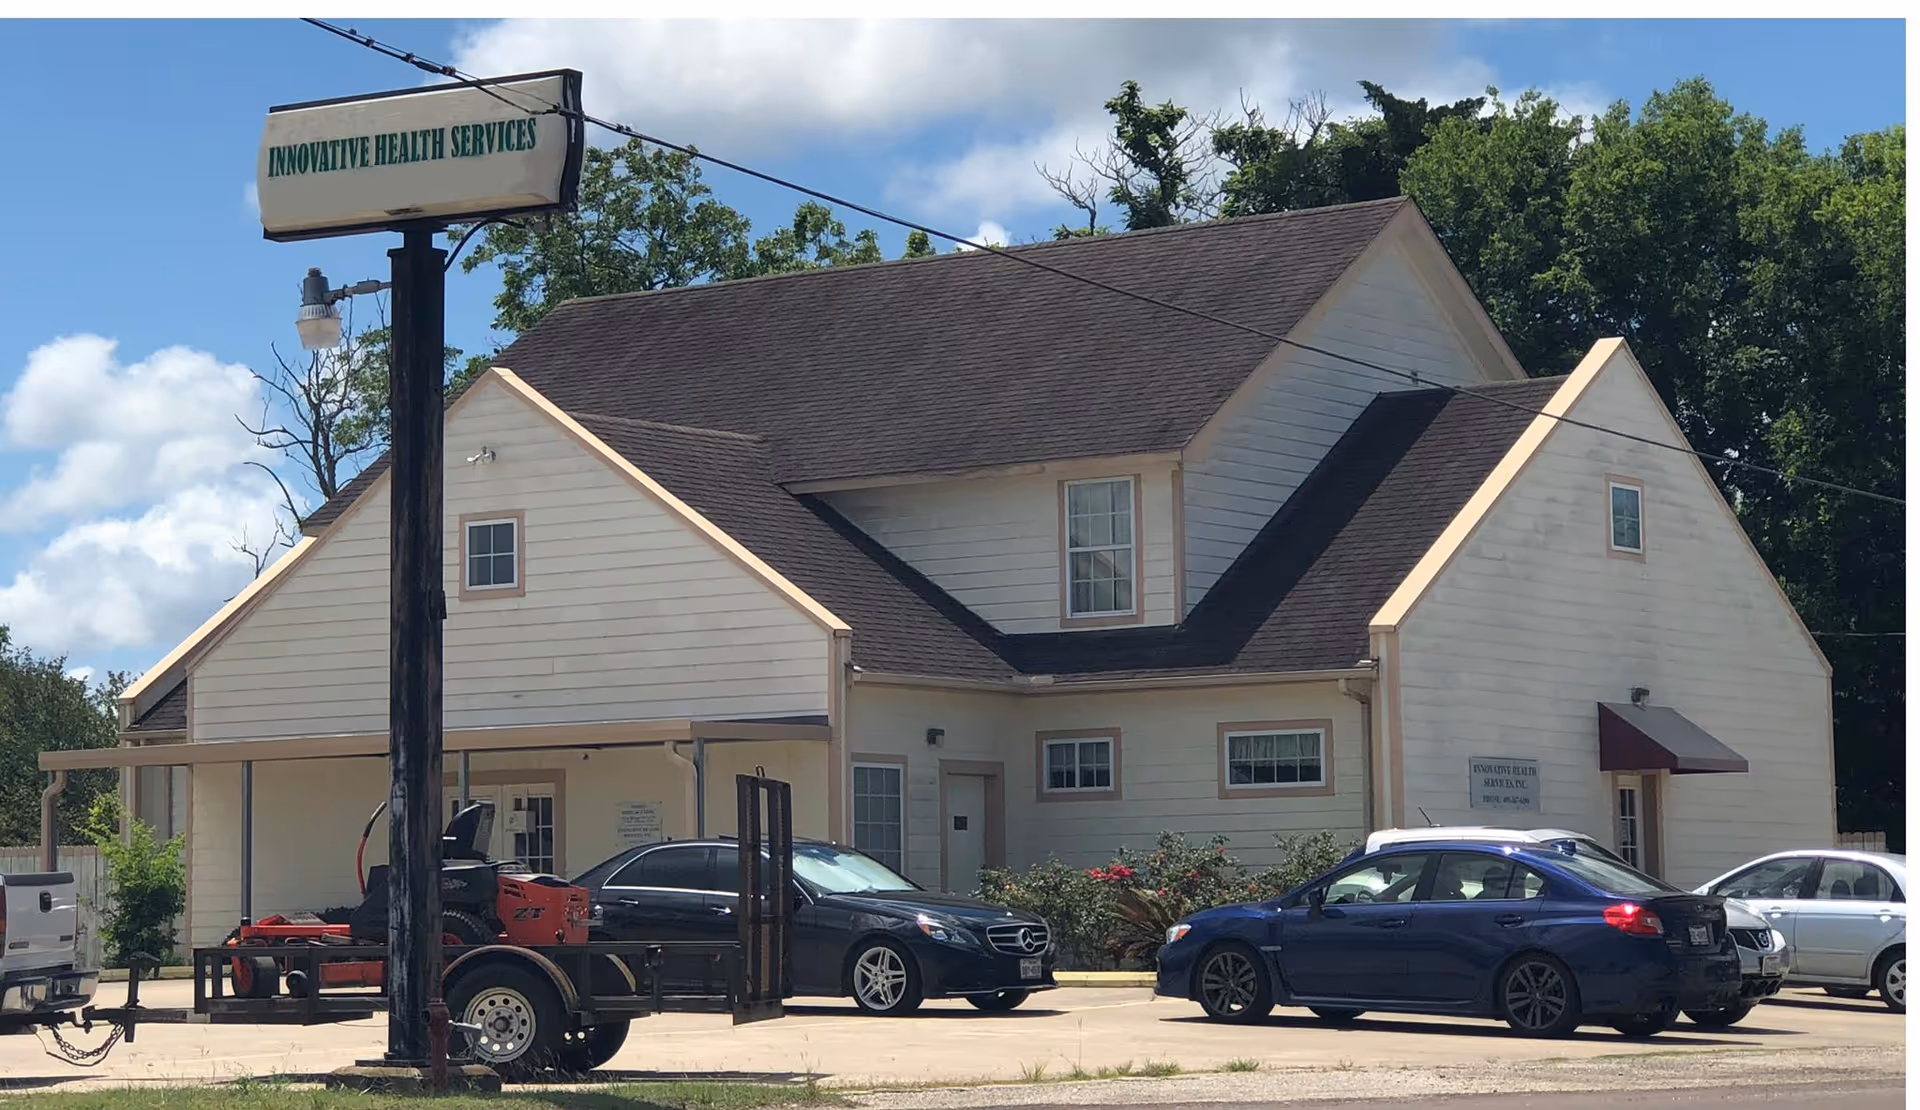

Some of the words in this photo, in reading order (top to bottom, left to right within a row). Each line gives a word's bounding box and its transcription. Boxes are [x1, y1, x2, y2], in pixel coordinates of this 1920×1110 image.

[268, 136, 370, 178] INNOVATIVE
[374, 127, 445, 167] HEALTH
[450, 117, 537, 158] SERVICES
[513, 907, 545, 922] ZT
